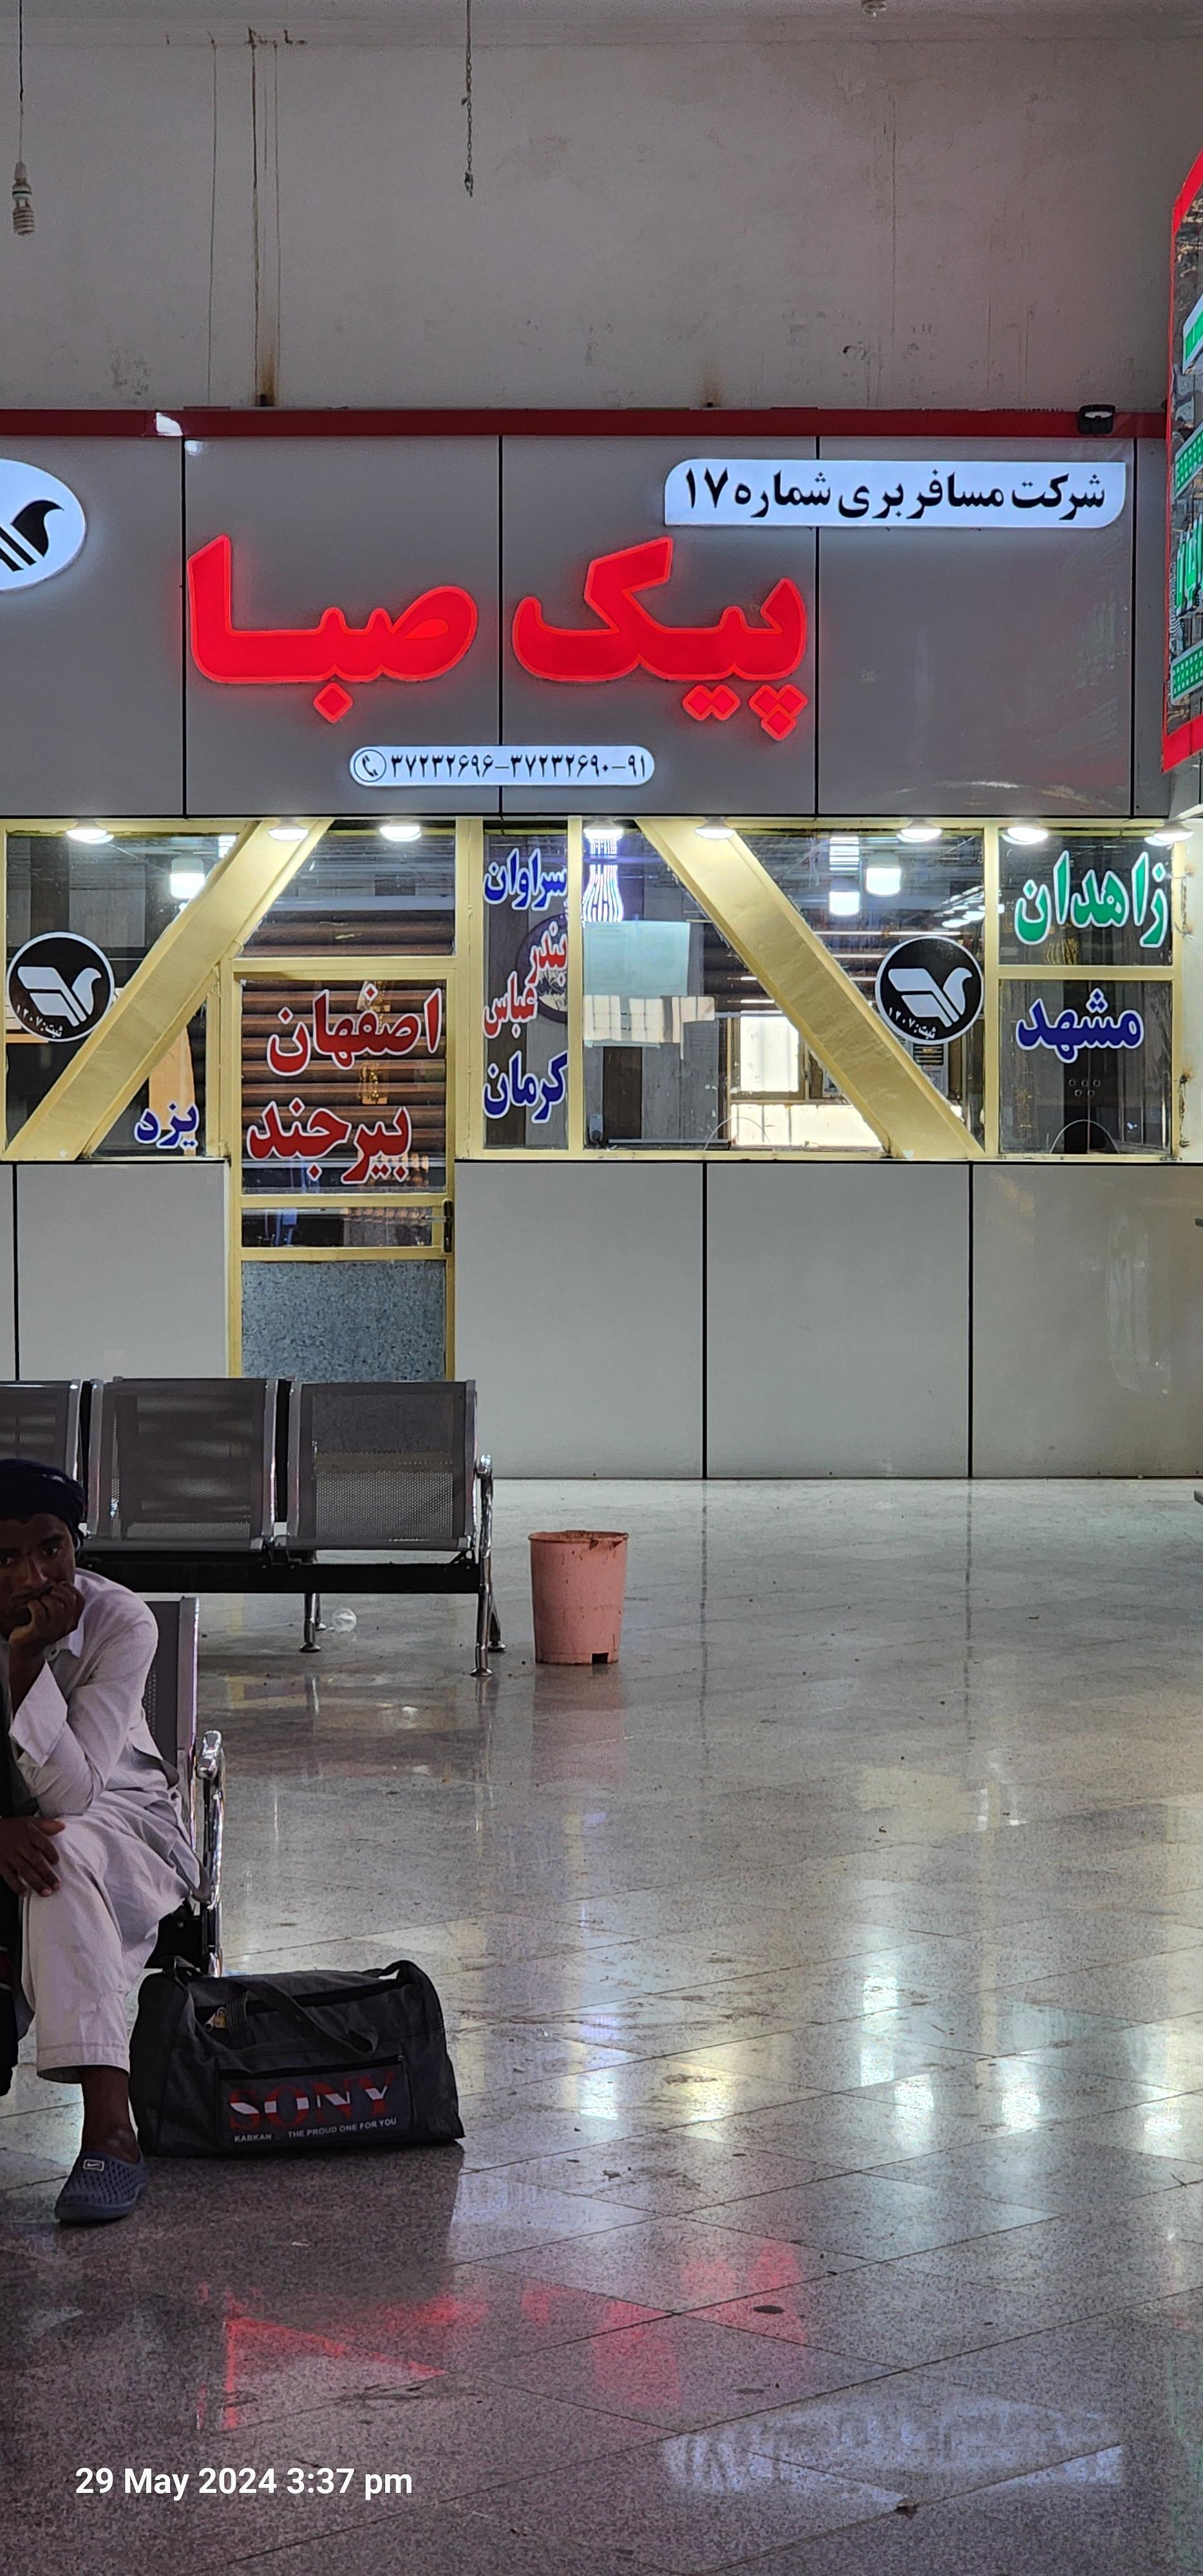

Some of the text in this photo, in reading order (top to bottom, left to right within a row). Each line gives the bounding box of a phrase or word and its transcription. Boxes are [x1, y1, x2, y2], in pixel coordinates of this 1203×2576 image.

[1012, 473, 1105, 520] شرکت
[187, 535, 809, 740] پیک صبا
[484, 848, 567, 910] سراوان
[1014, 850, 1168, 948] زاهدان
[525, 921, 567, 986] بندر
[267, 983, 442, 1076] اصفهان
[484, 971, 538, 1039] عباس
[1016, 988, 1144, 1063] مشهد
[483, 1050, 568, 1123] کرمان
[135, 1102, 200, 1149] یزد
[246, 1098, 412, 1184] بیرجند
[229, 2070, 395, 2130] SONY
[288, 2117, 397, 2138] THE PROUD ONE FOR YOU
